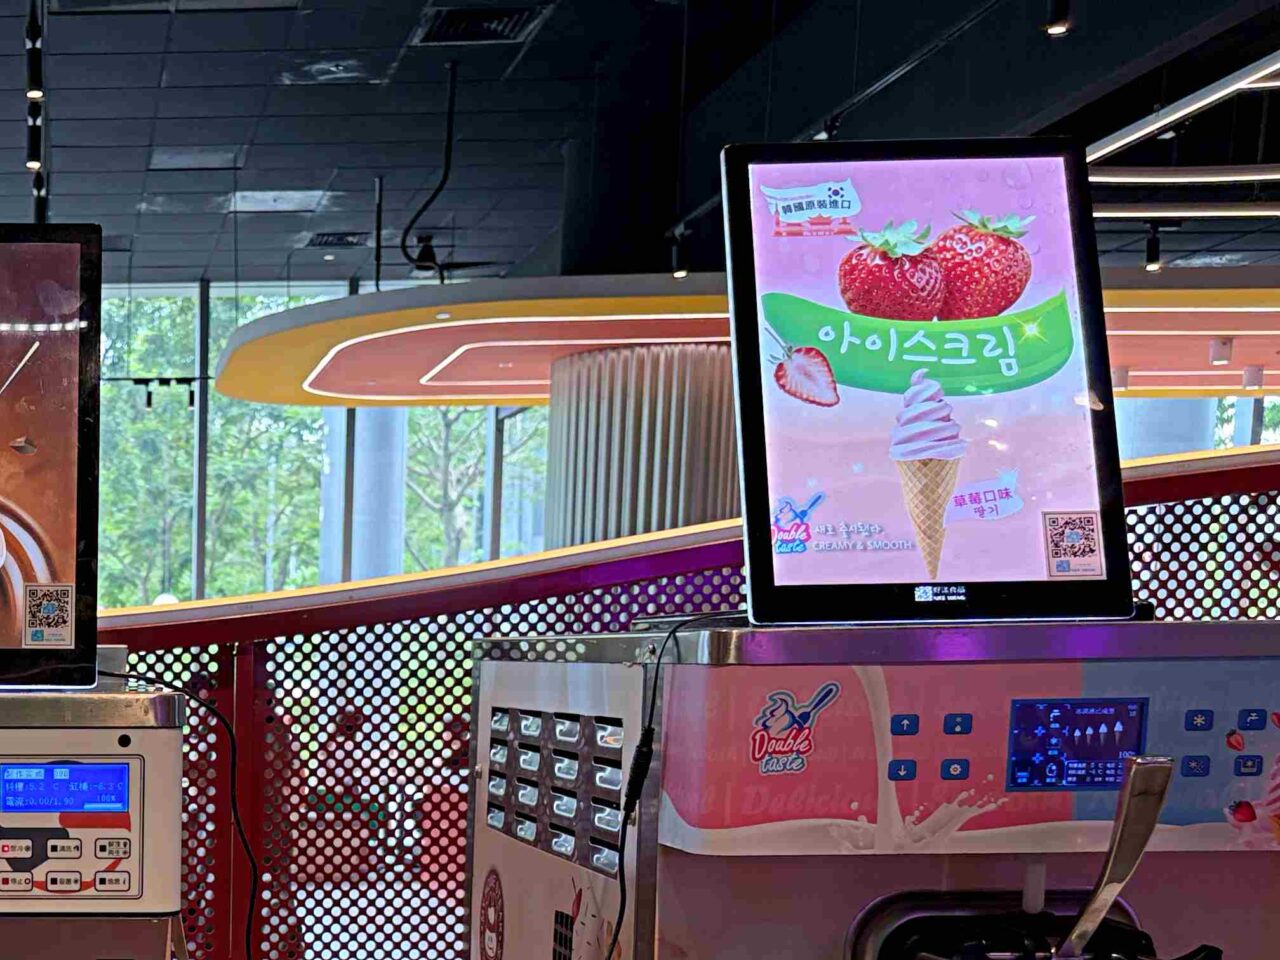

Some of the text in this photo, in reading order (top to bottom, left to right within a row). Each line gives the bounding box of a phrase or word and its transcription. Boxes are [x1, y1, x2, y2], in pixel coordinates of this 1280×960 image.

[818, 321, 1019, 376] 아이스크림
[954, 487, 1013, 508] 草莓口味
[974, 504, 999, 518] 딸기
[775, 541, 806, 552] taste
[813, 540, 852, 550] CREAMY
[867, 540, 912, 550] SMOOTH
[754, 728, 811, 759] Double
[761, 752, 804, 772] taste
